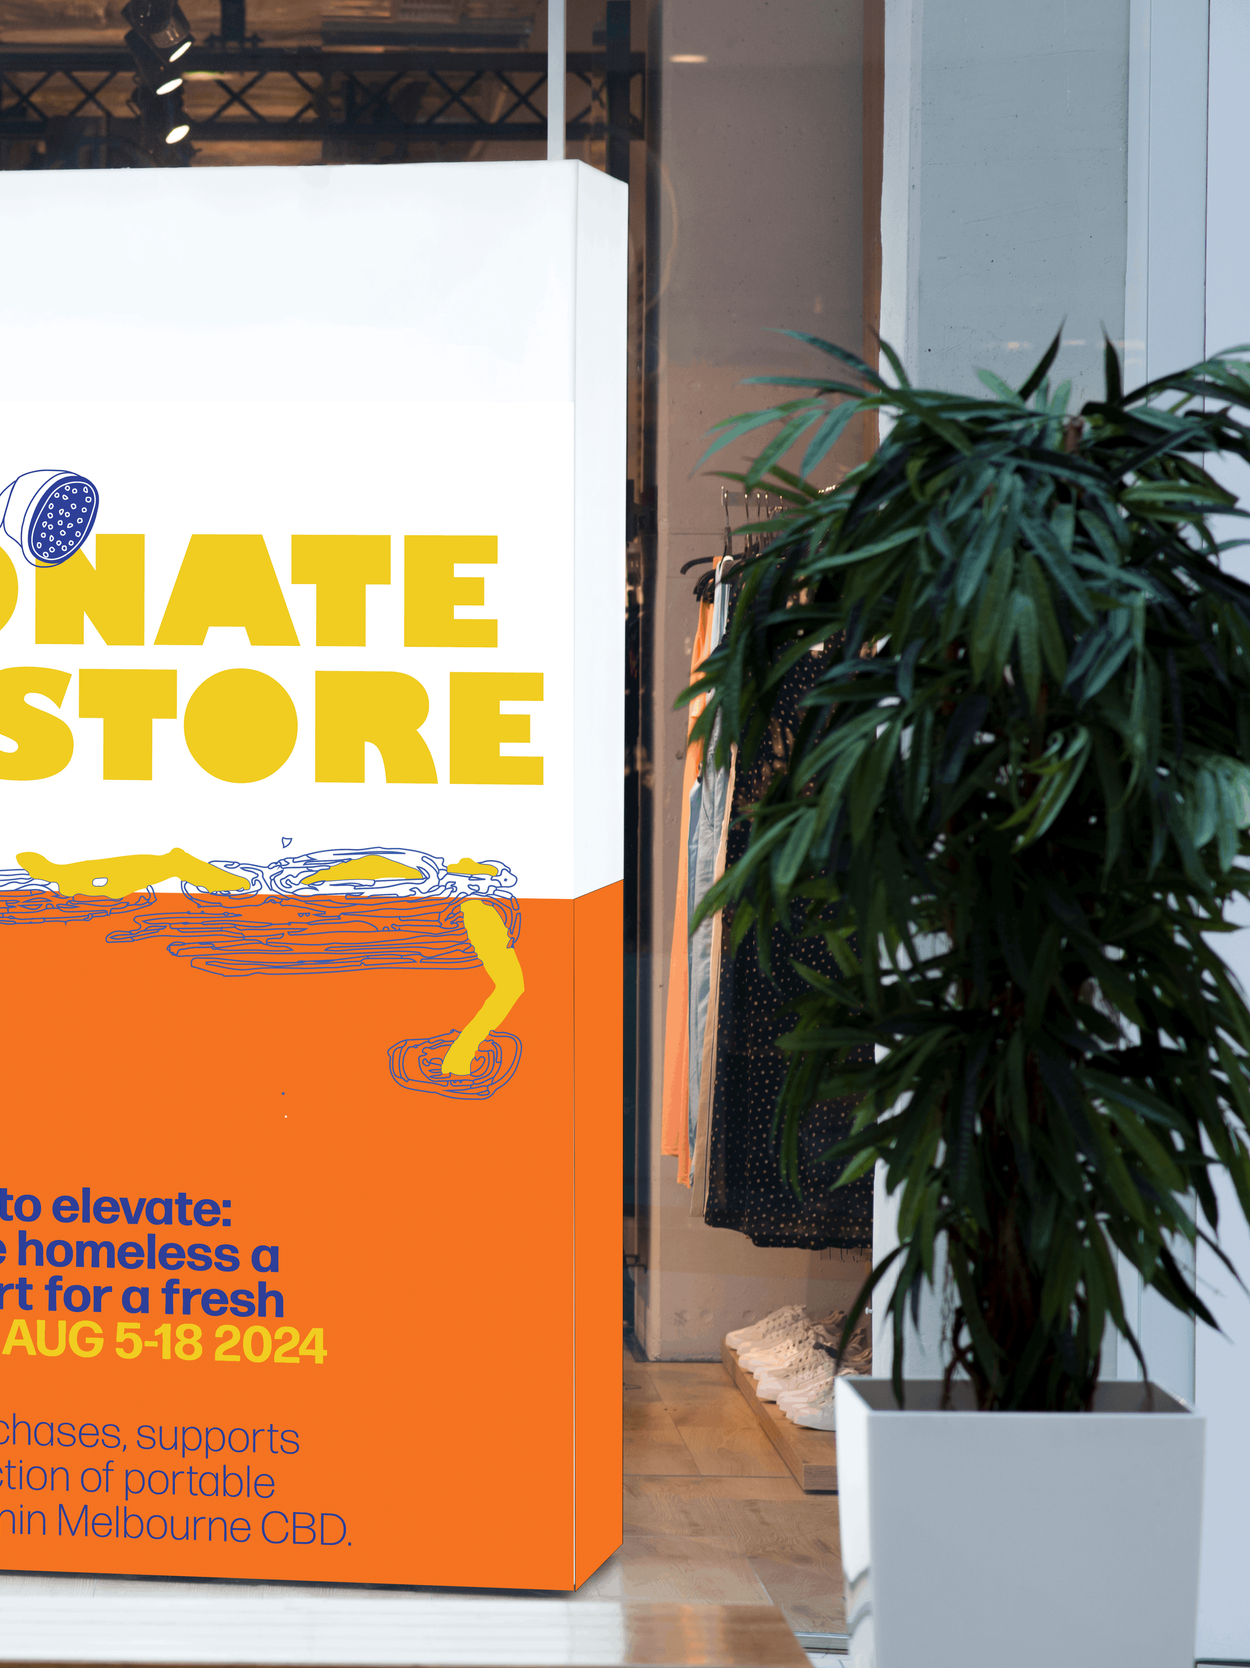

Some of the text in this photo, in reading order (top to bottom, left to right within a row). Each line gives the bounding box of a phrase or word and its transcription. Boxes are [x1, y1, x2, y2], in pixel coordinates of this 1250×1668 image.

[51, 1186, 232, 1227] elevate:
[17, 1229, 241, 1273] homeless
[250, 1244, 280, 1273] a
[44, 1274, 113, 1313] for
[121, 1285, 150, 1314] a
[160, 1277, 284, 1318] fresh
[1, 1318, 105, 1358] AUG
[115, 1321, 203, 1361] 5-18
[214, 1324, 328, 1365] 2024
[136, 1423, 300, 1460] supports
[80, 1459, 115, 1493] of
[124, 1464, 275, 1502] portable
[58, 1503, 252, 1543] Melbourne
[261, 1510, 352, 1547] CBD.
